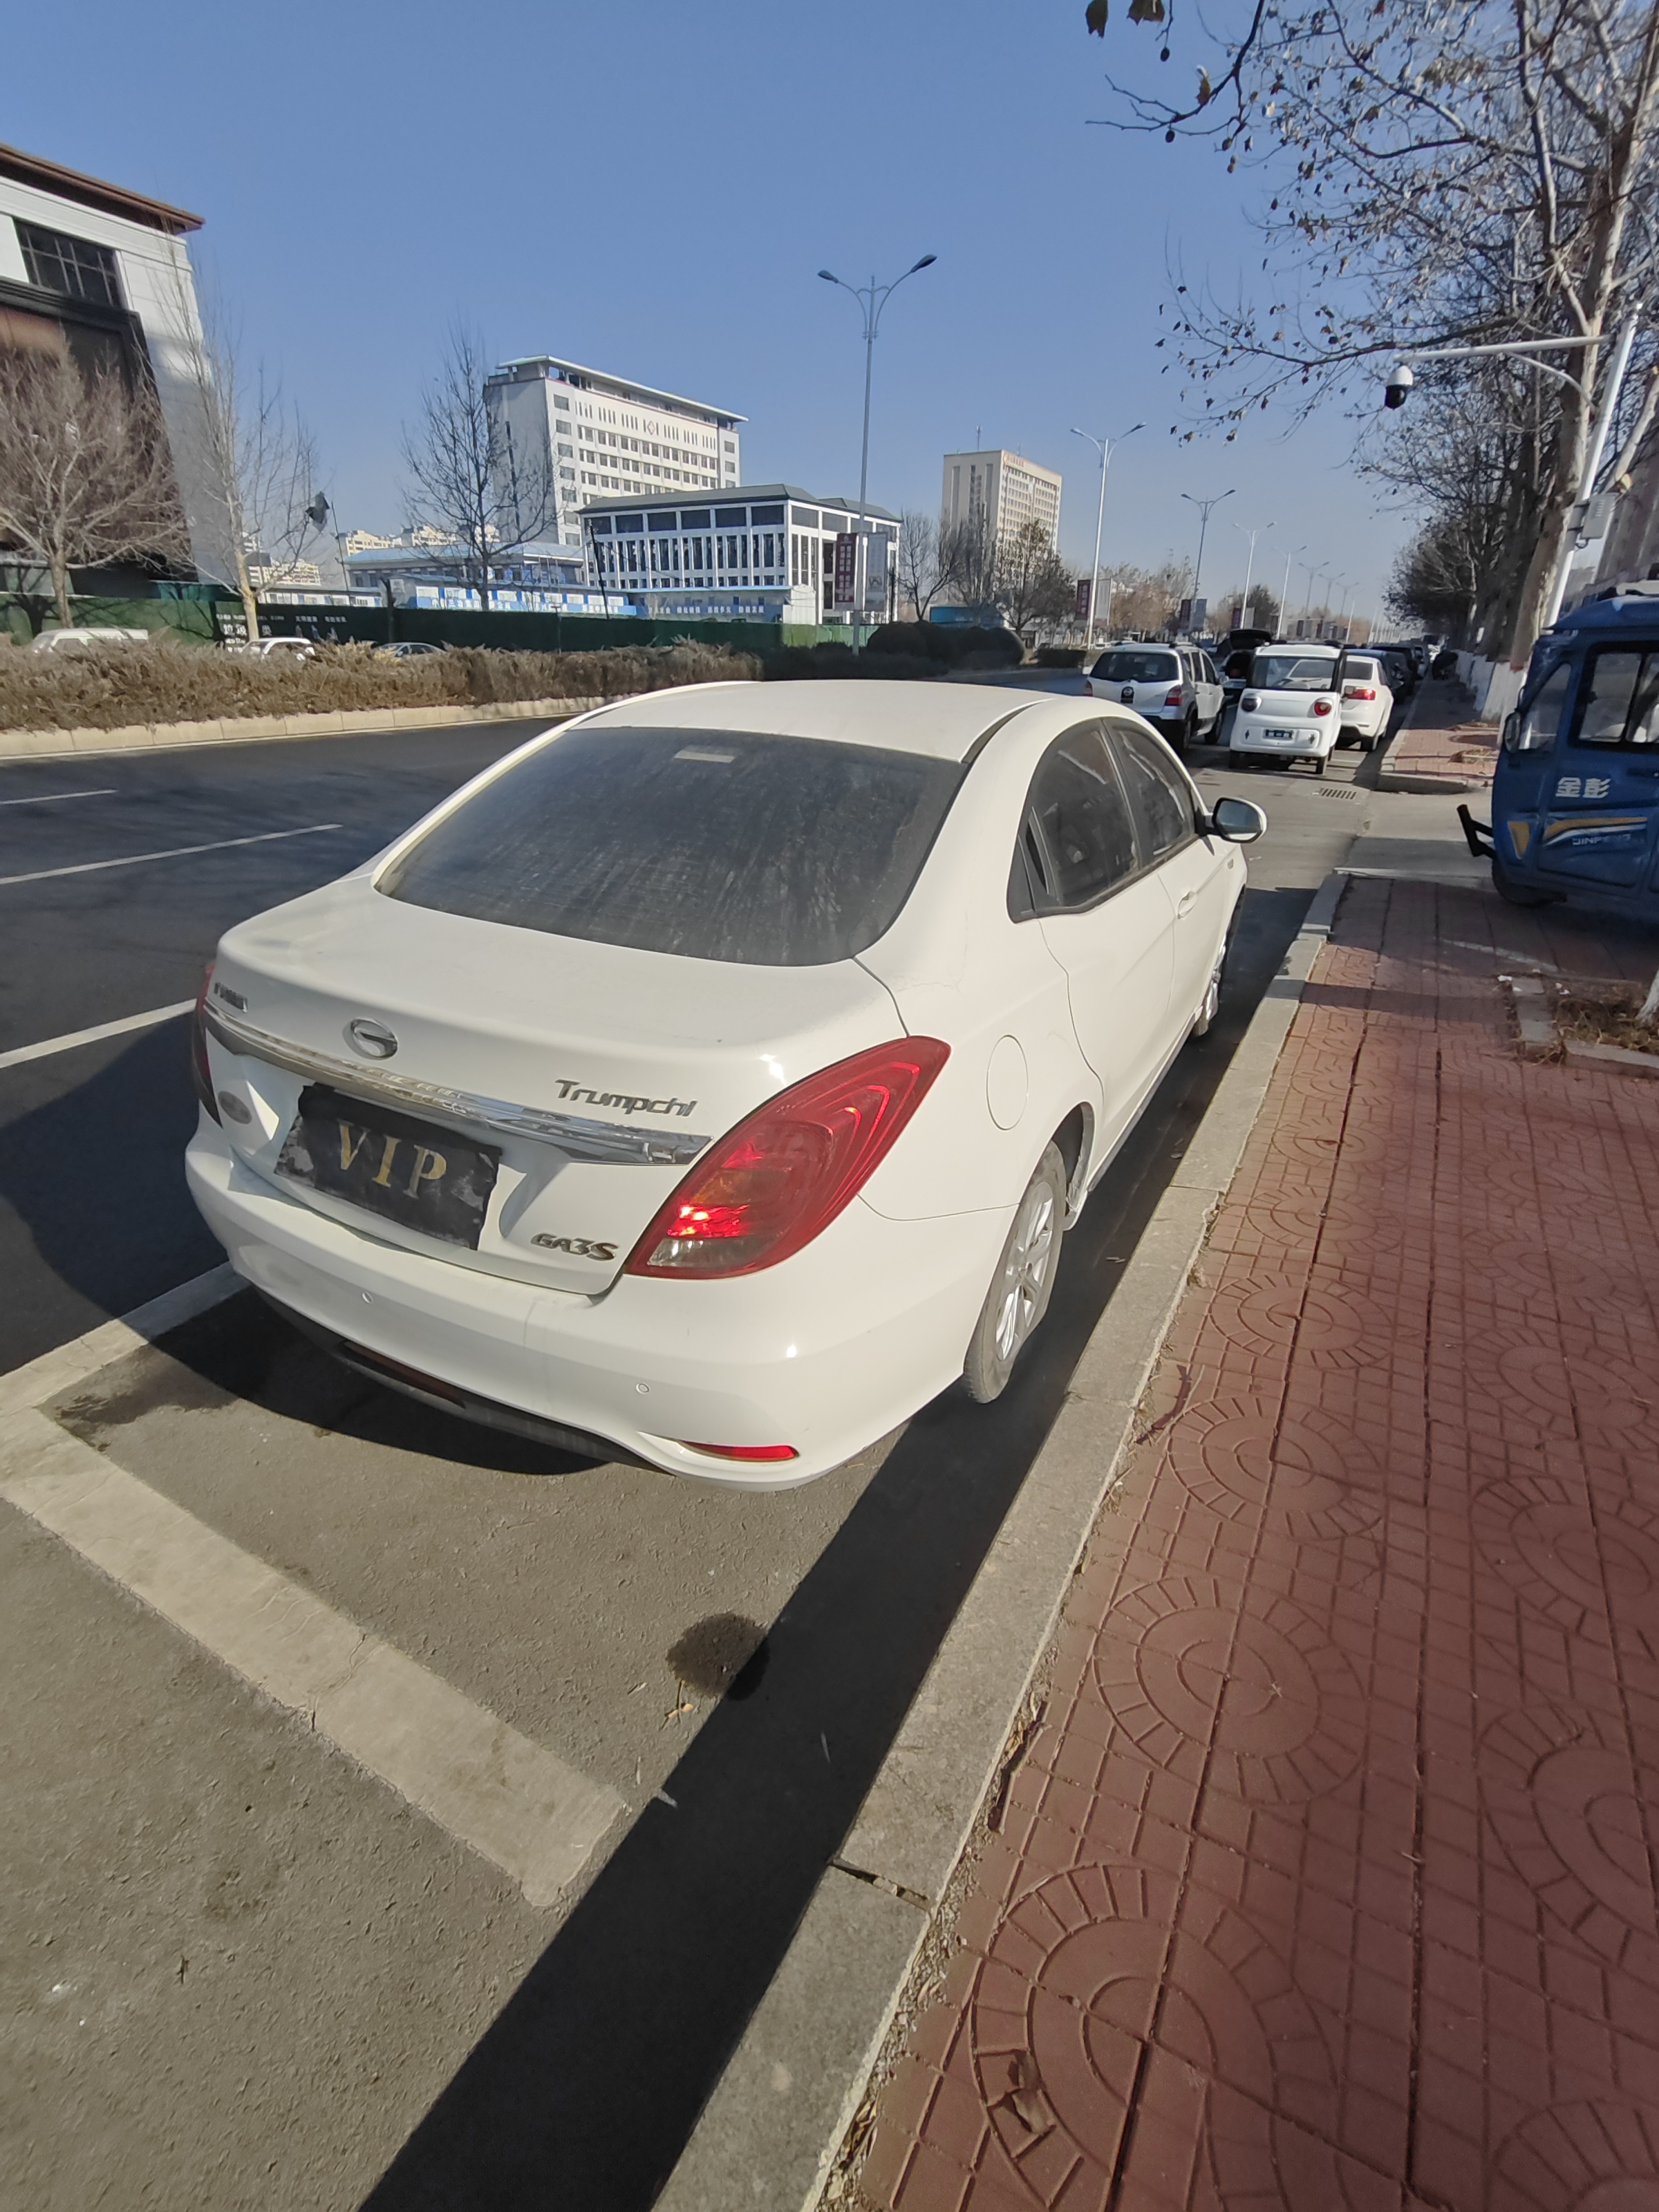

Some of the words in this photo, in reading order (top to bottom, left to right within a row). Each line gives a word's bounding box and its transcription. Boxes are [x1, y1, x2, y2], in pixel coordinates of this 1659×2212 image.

[1555, 777, 1611, 798] 金彭
[555, 1079, 698, 1117] Trumpchi
[337, 1118, 447, 1199] VIP
[529, 1232, 619, 1262] GA3S
